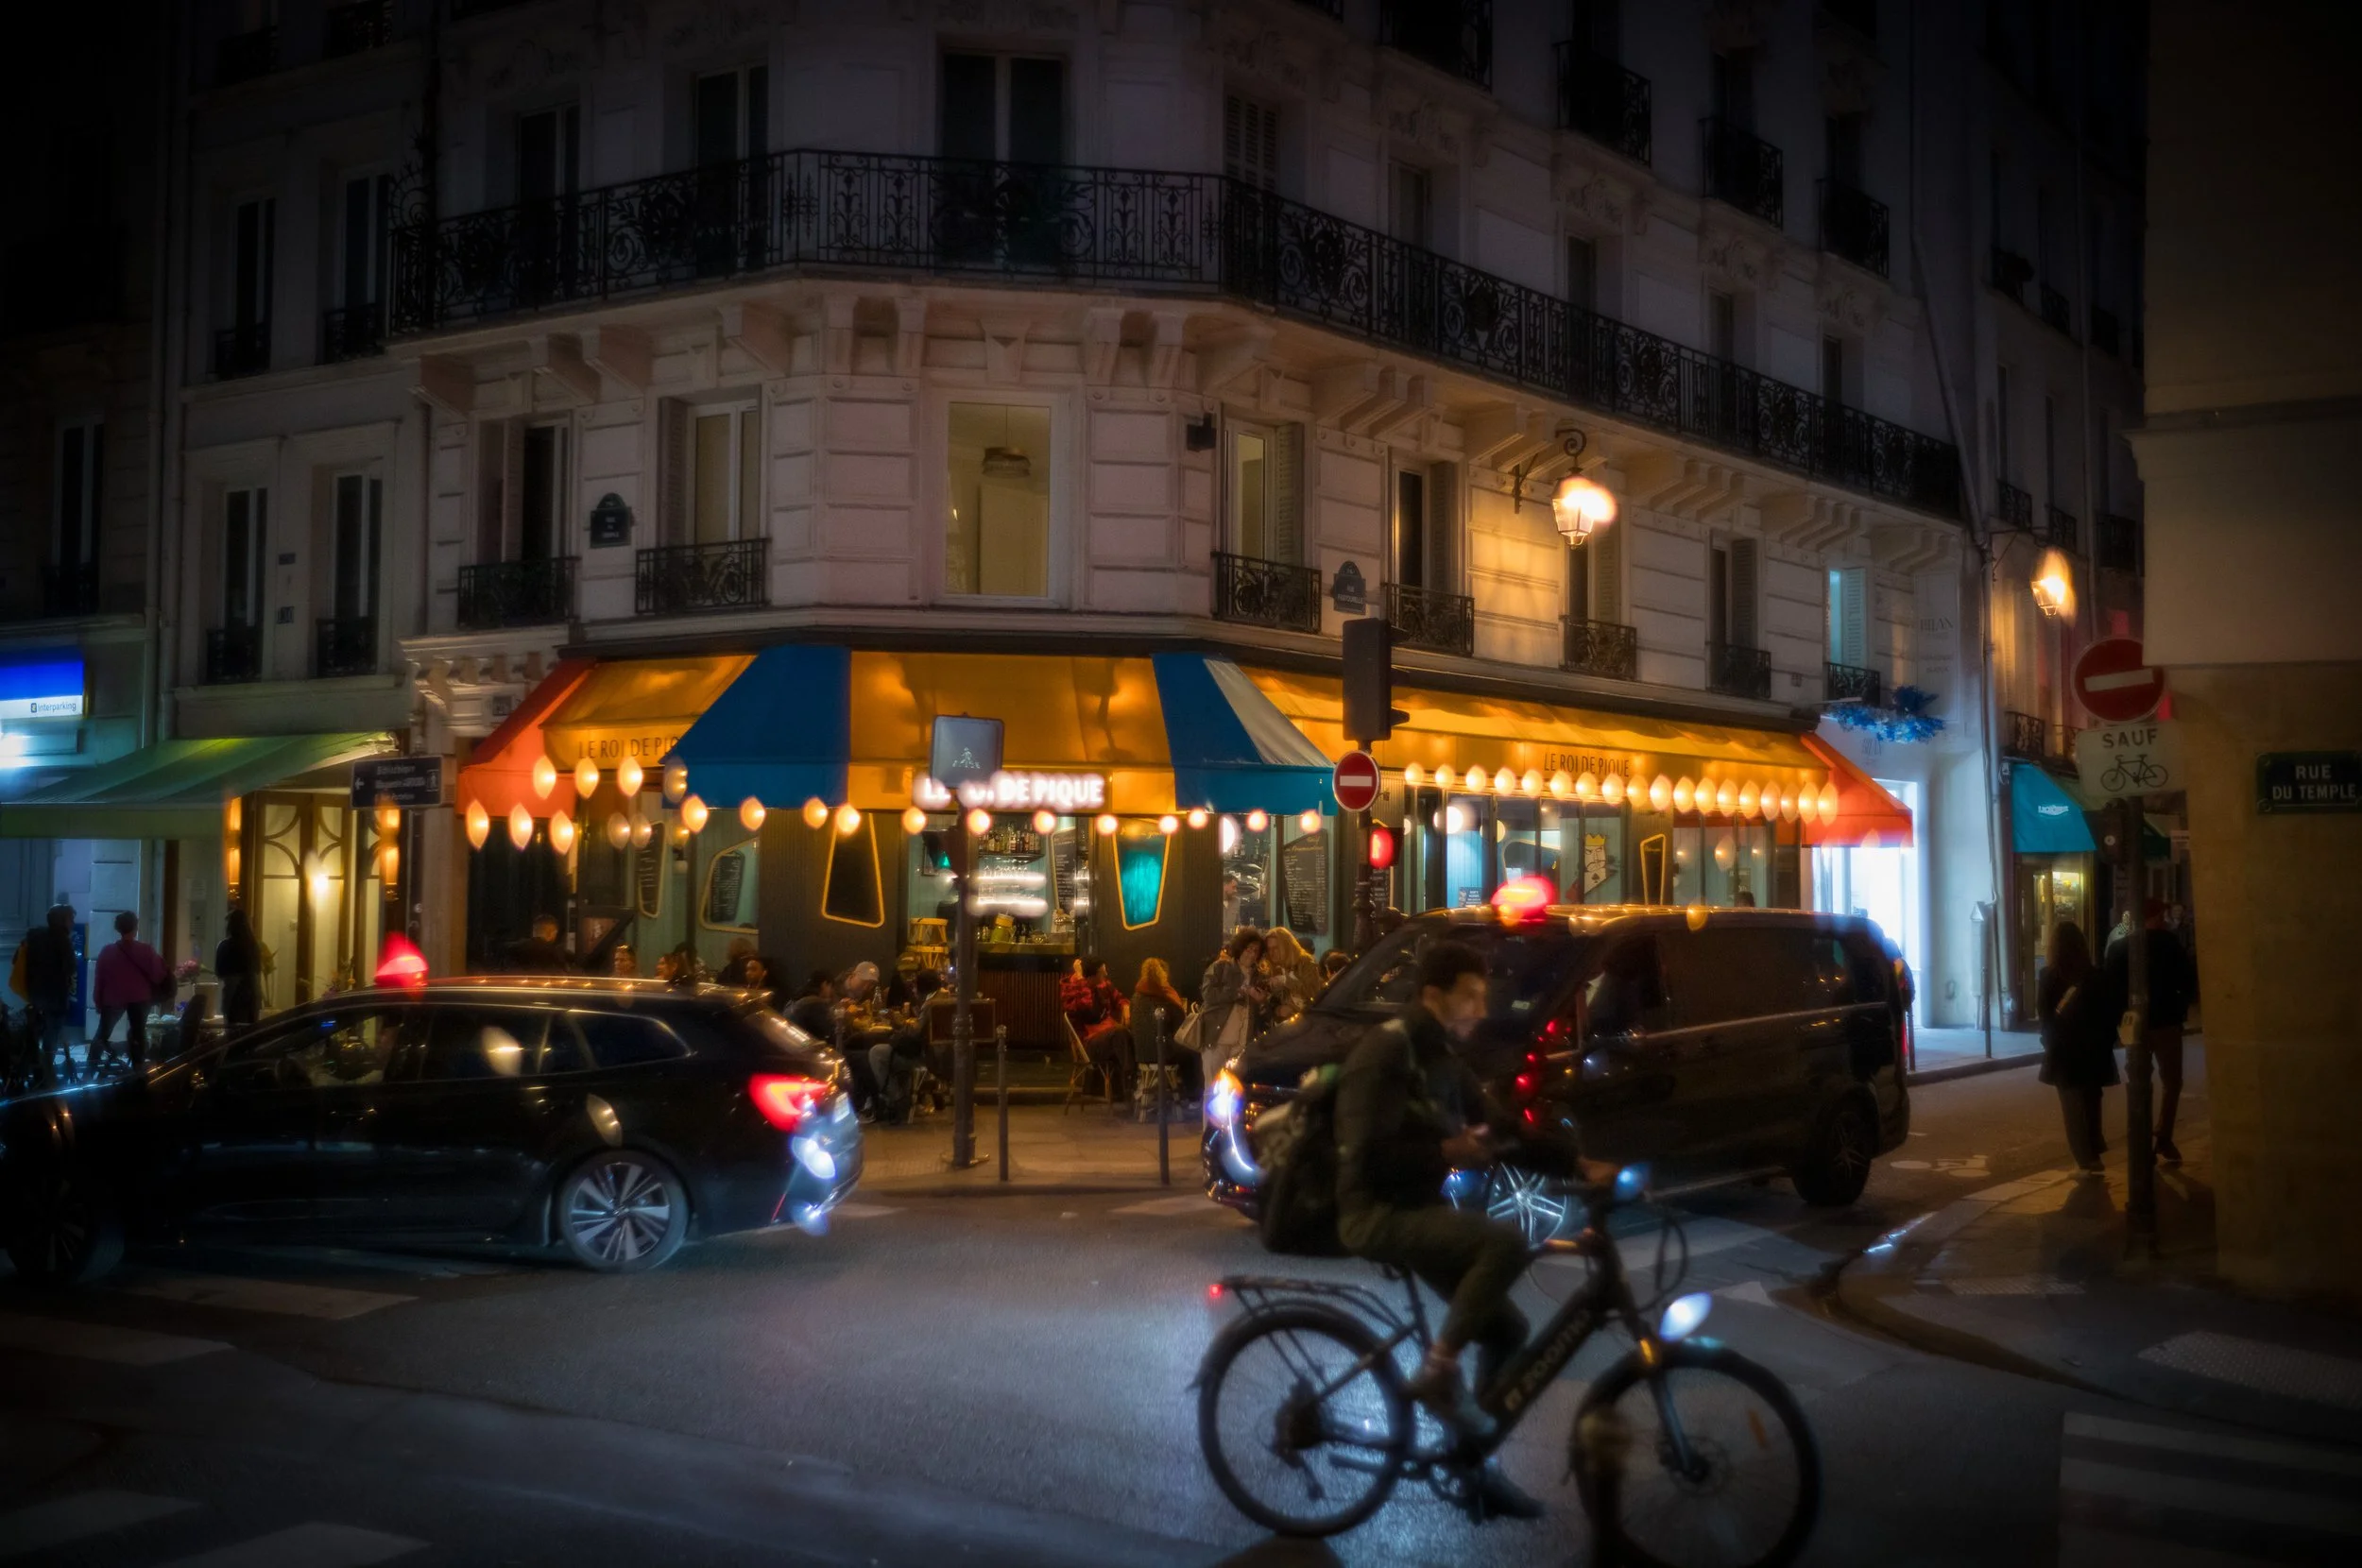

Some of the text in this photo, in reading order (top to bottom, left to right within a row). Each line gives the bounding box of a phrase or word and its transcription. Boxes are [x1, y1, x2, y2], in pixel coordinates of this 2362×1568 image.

[578, 740, 596, 759] LE
[601, 739, 625, 758] ROI
[630, 737, 651, 757] DE
[2102, 728, 2158, 748] SAUF
[1544, 753, 1630, 777] LE ROI DE PIQUE
[2295, 764, 2332, 780] RUE
[999, 777, 1031, 802] DE
[1034, 777, 1104, 808] PIQUE
[2272, 782, 2357, 801] DU TEMPLE
